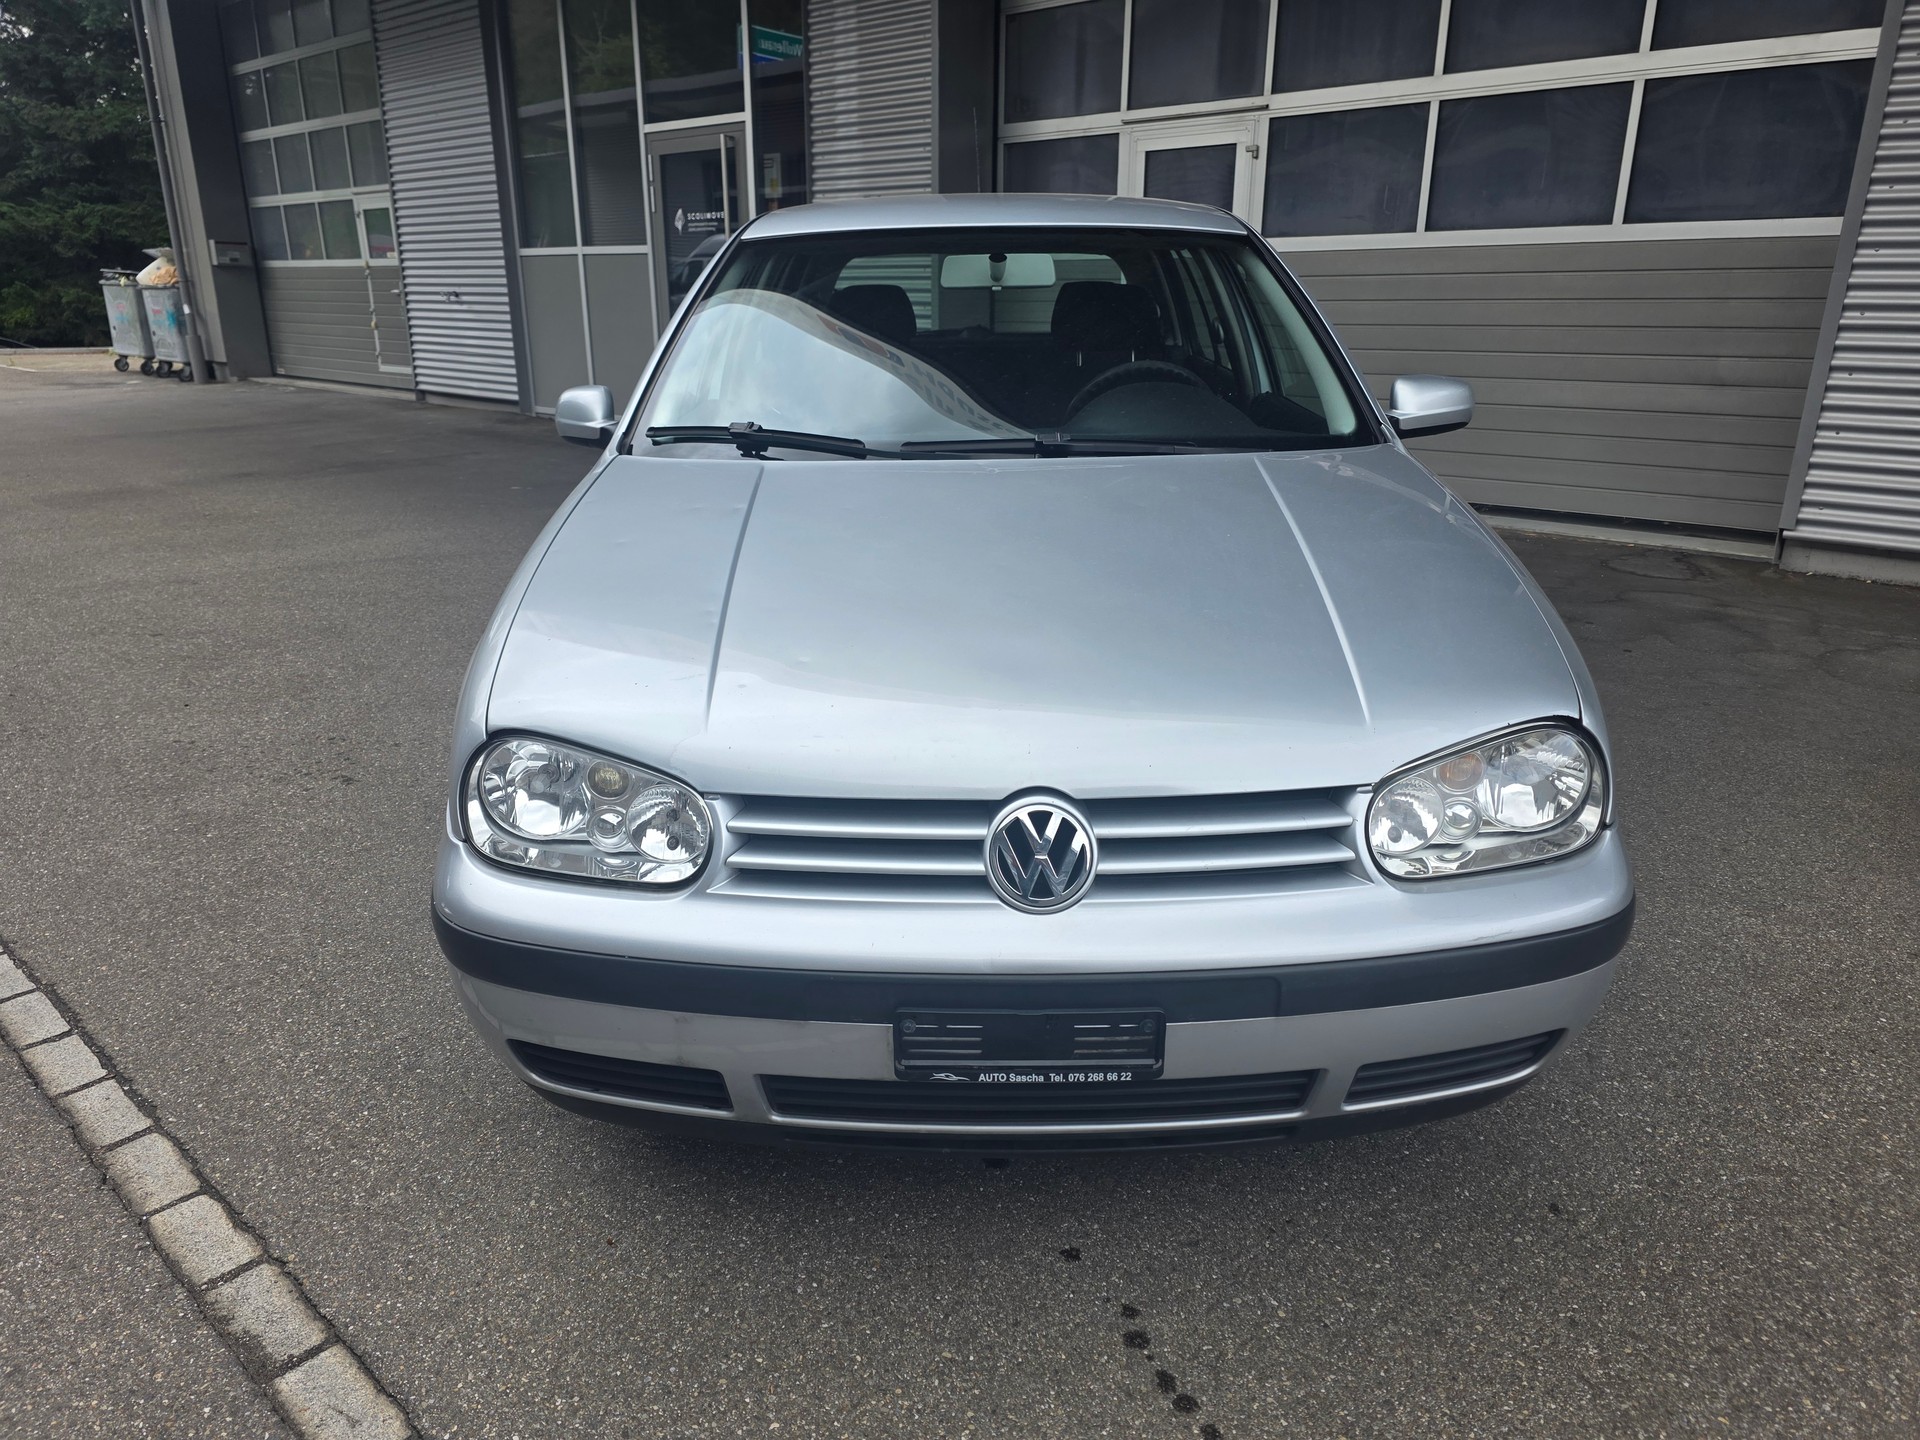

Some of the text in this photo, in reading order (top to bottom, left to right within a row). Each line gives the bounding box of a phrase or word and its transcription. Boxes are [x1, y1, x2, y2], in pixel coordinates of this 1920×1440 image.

[978, 1072, 1132, 1082] AUTO Sascha Tel. 076 268 66 22
